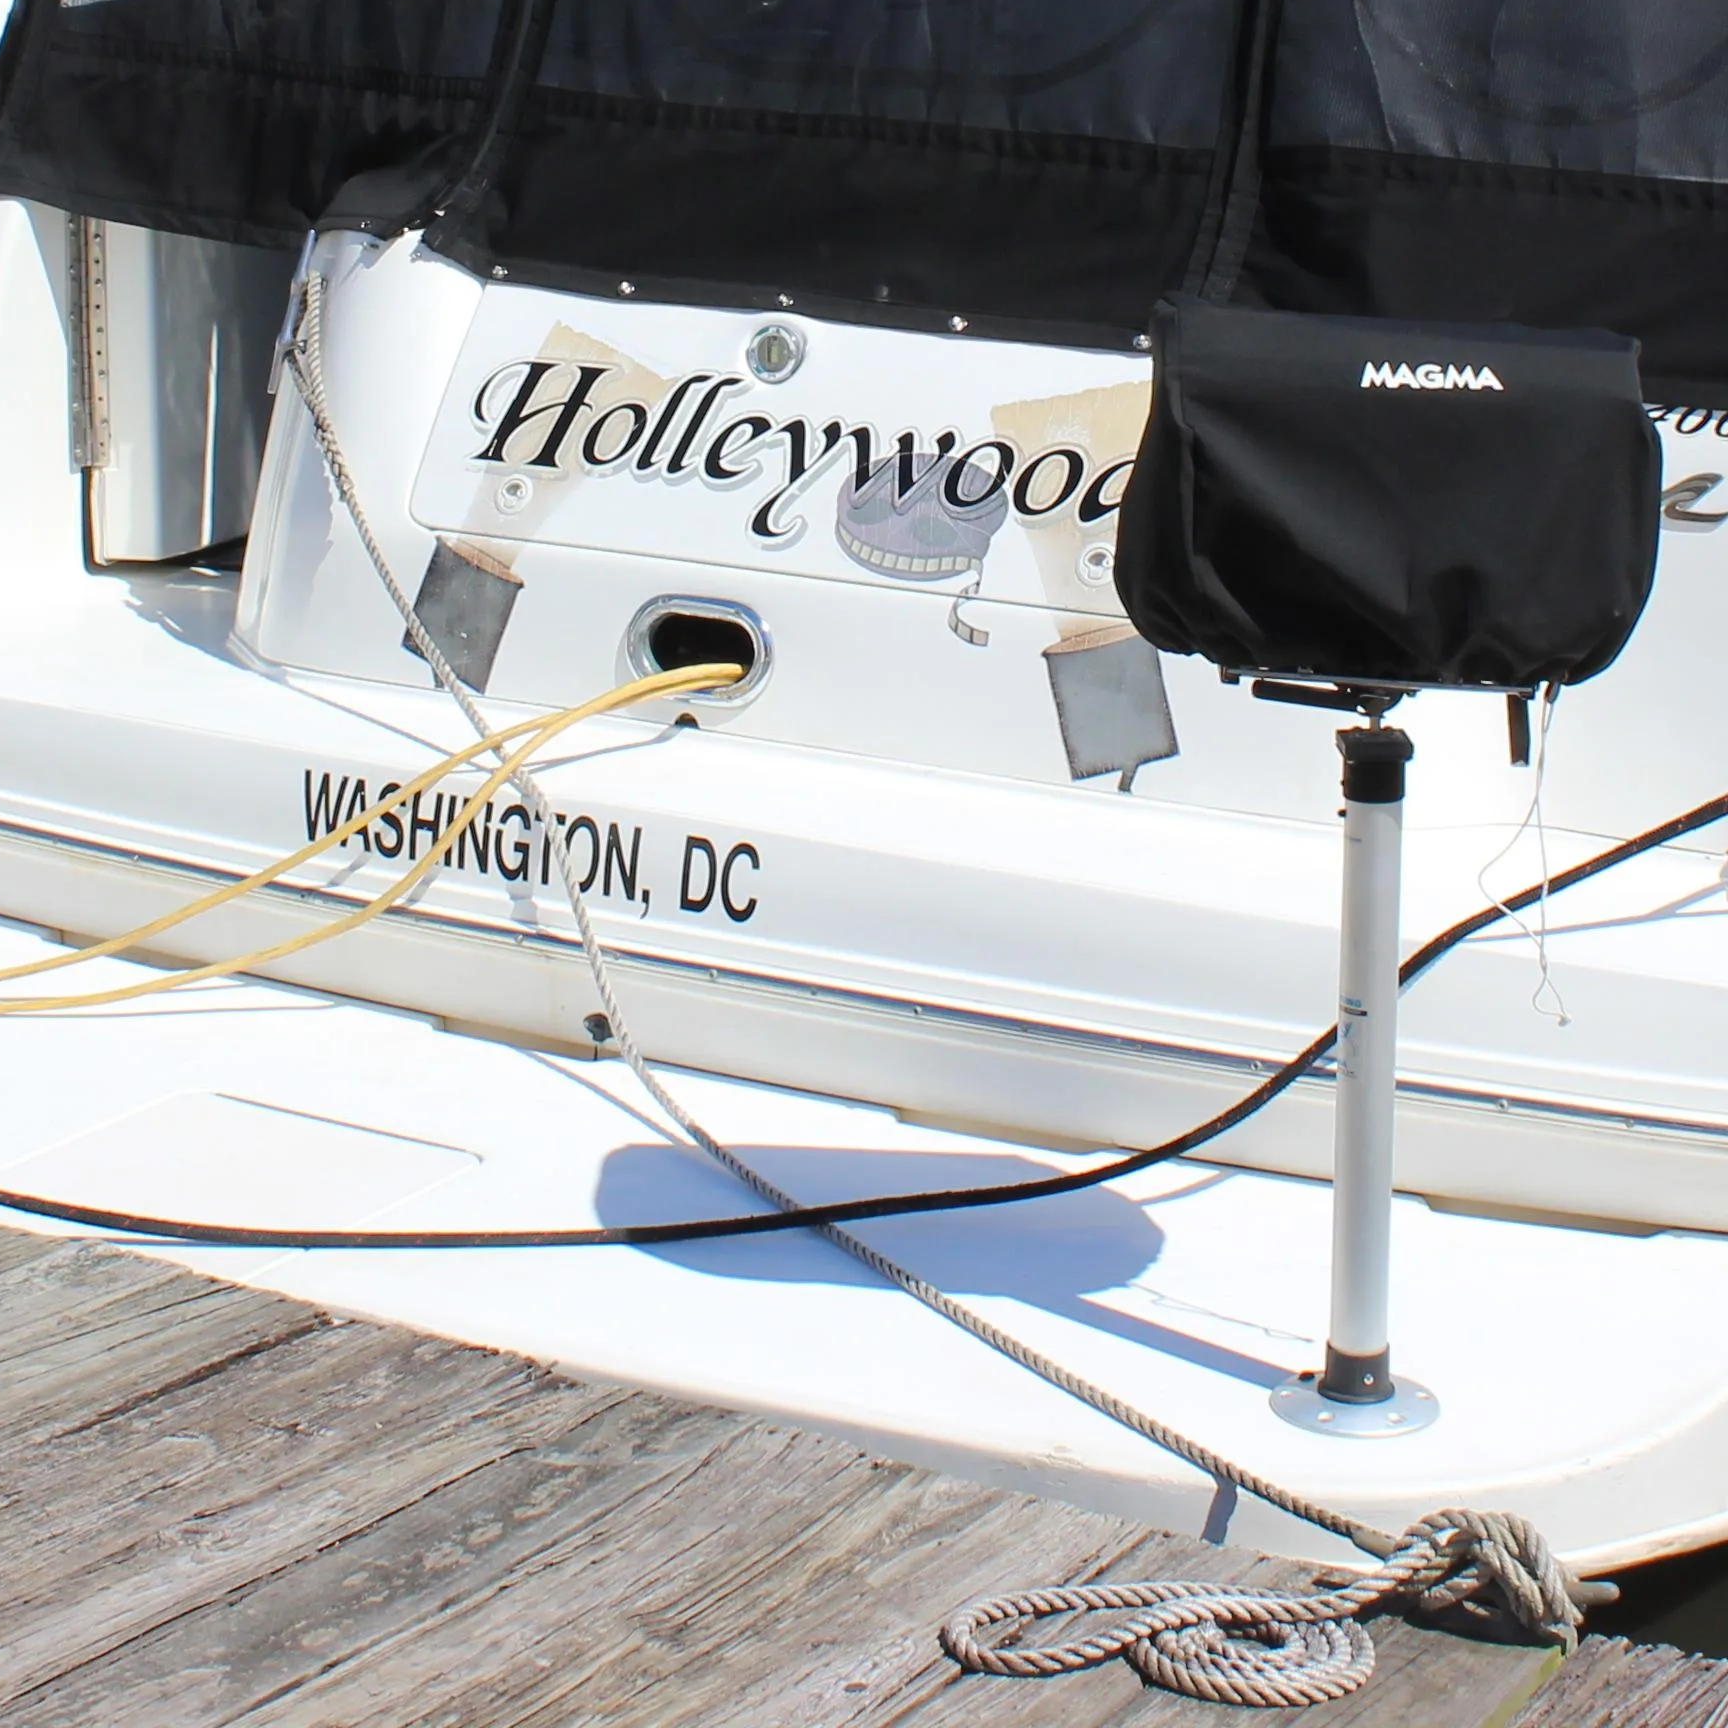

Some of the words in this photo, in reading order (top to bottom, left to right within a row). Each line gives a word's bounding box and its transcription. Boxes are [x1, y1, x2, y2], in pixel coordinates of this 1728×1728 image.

[1360, 360, 1505, 391] MAGMA
[304, 768, 651, 921] WASHINGTON,
[679, 834, 761, 924] DC
